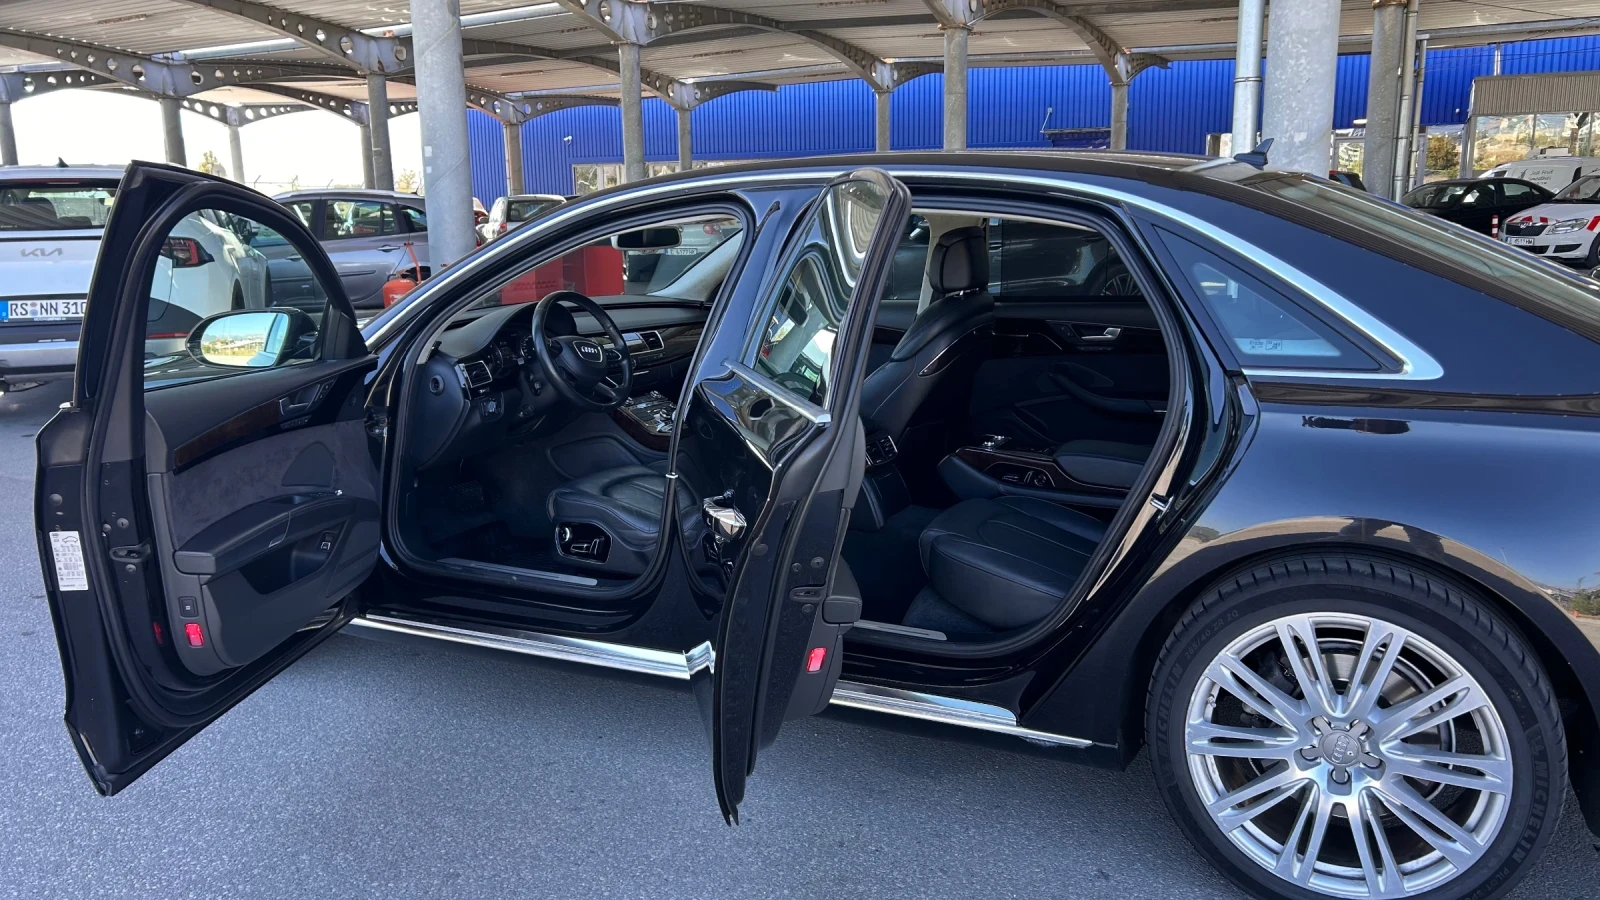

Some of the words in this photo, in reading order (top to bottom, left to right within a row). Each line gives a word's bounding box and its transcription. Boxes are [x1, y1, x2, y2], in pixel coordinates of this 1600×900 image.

[20, 247, 63, 257] KIA
[10, 302, 29, 316] RS
[40, 302, 58, 315] NN
[1156, 663, 1184, 757] MICHELIN
[1511, 760, 1549, 864] MICHELIN
